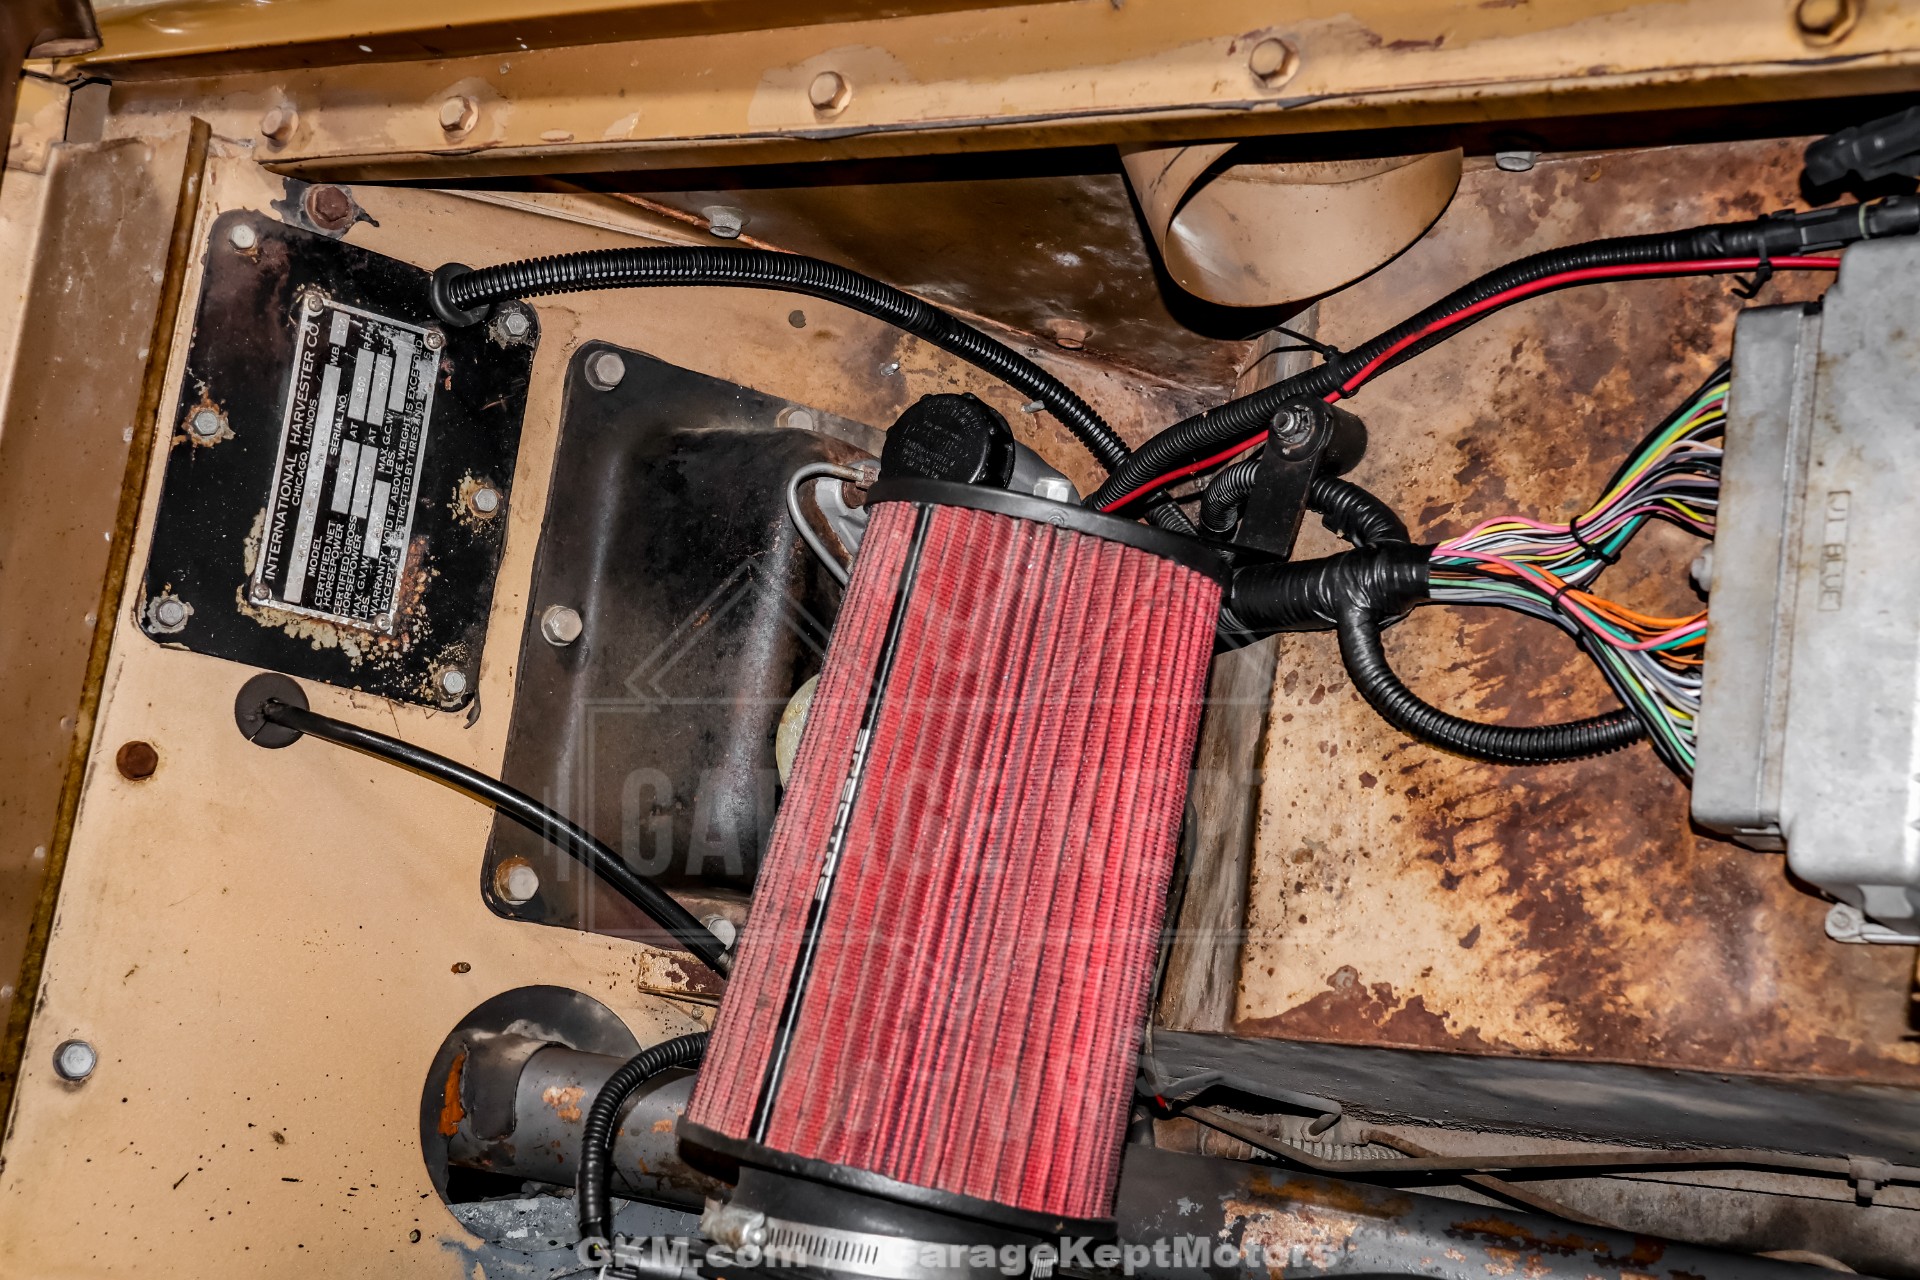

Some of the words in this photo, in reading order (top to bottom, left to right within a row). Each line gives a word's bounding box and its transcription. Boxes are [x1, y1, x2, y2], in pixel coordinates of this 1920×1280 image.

[330, 344, 340, 366] W.B.
[329, 413, 343, 455] SERIAL
[337, 392, 347, 413] NO.
[404, 401, 412, 413] IS
[349, 421, 358, 438] AT
[368, 427, 376, 443] AT
[397, 415, 411, 461] WEIGHT
[407, 425, 419, 459] TIRES
[264, 451, 297, 580] INTERNATIONAL
[290, 350, 314, 445] HARVESTER
[291, 449, 309, 506] CHICAGO,
[301, 398, 317, 447] ILLINOIS
[378, 445, 388, 472] MAX.
[385, 448, 396, 475] LBS.
[404, 459, 413, 475] BY
[390, 461, 403, 502] ABOVE
[387, 504, 395, 515] IF
[307, 534, 322, 577] MODEL
[313, 545, 331, 606] CERTIFIED
[325, 519, 336, 544] NET
[322, 523, 344, 606] HORSEPOWER
[333, 555, 350, 615] CERTIFIED
[344, 514, 357, 555] GROSS
[341, 534, 362, 617] HORSEPOWER
[388, 548, 398, 565] AS
[351, 590, 363, 618] MAX.
[357, 555, 369, 589] G.V.W.
[370, 551, 387, 616] WARRANTY
[380, 566, 394, 610] EXCEPT
[359, 593, 370, 620] LBS.
[813, 728, 871, 900] SPECTRE
